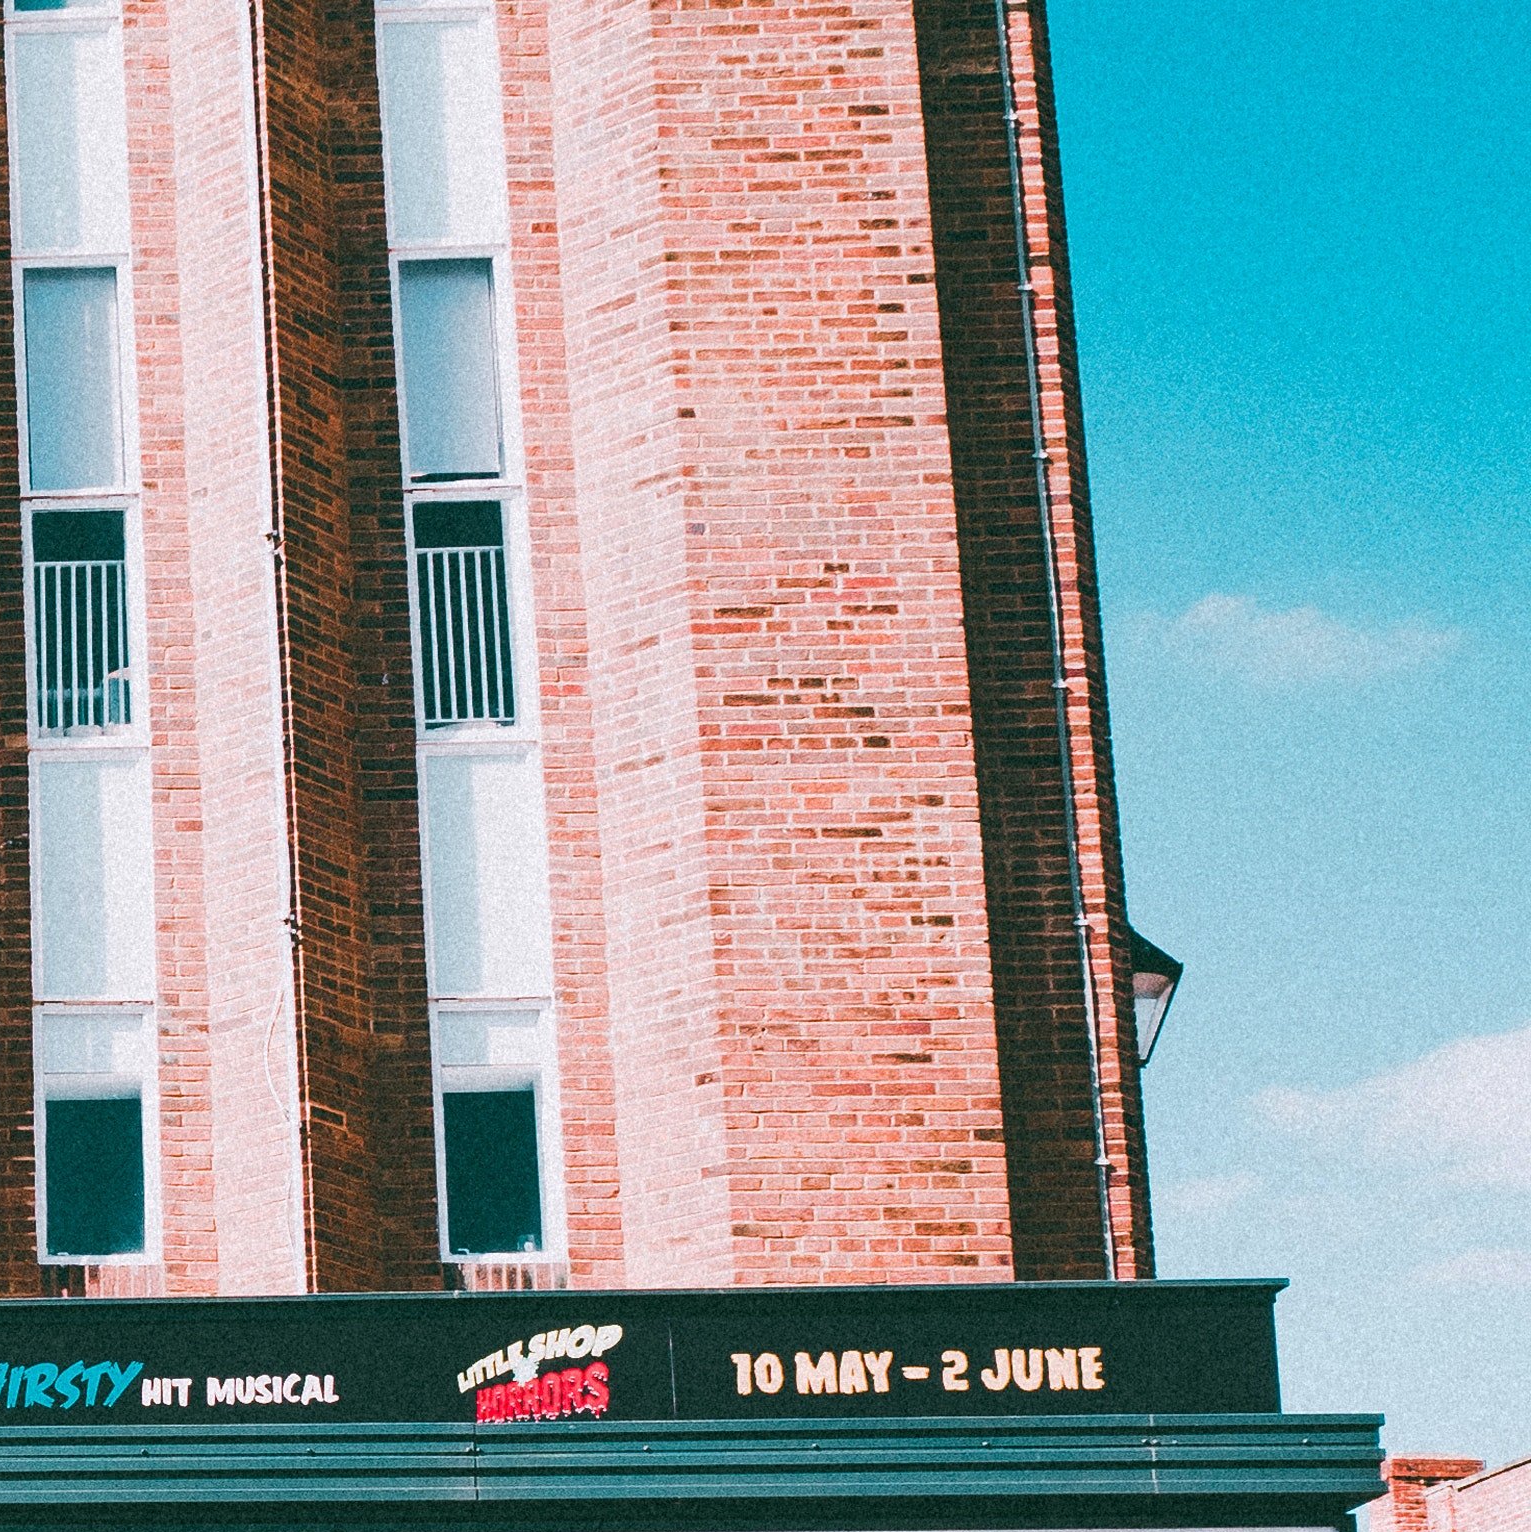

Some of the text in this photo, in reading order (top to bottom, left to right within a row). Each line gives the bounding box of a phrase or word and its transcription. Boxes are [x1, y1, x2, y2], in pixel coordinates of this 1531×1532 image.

[527, 1323, 624, 1361] SHOP
[142, 1376, 193, 1408] HIT
[206, 1374, 341, 1408] MUSICAL
[475, 1361, 611, 1425] HORRORS
[732, 1352, 784, 1397] 10
[794, 1349, 894, 1396] MAY
[941, 1349, 970, 1393] 2
[980, 1346, 1105, 1393] JUNE
